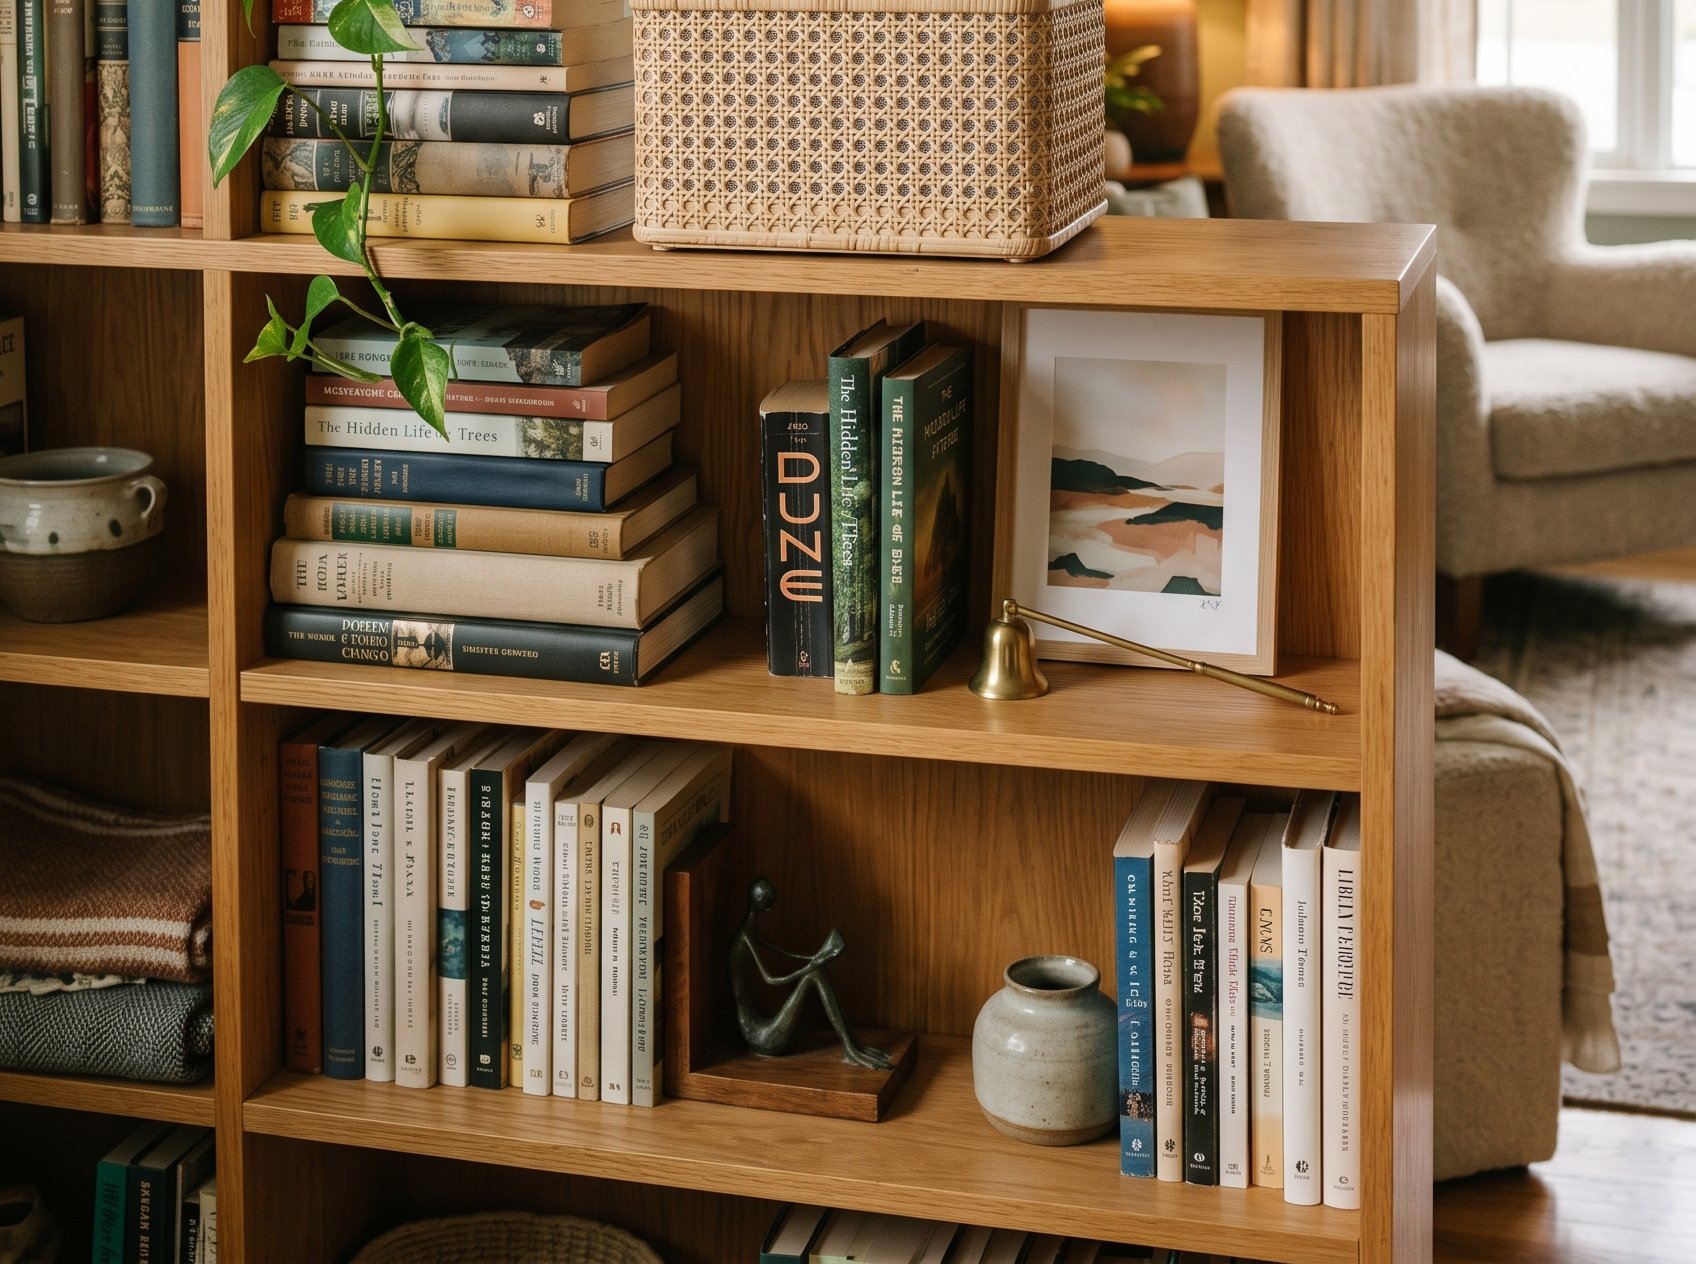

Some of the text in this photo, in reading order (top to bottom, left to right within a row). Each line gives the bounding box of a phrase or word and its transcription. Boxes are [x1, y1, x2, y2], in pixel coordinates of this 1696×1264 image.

[841, 374, 855, 403] The
[892, 396, 904, 423] THE
[317, 420, 498, 443] The Hidden Life Trees
[840, 409, 859, 472] Hidden
[777, 451, 823, 603] DUNE
